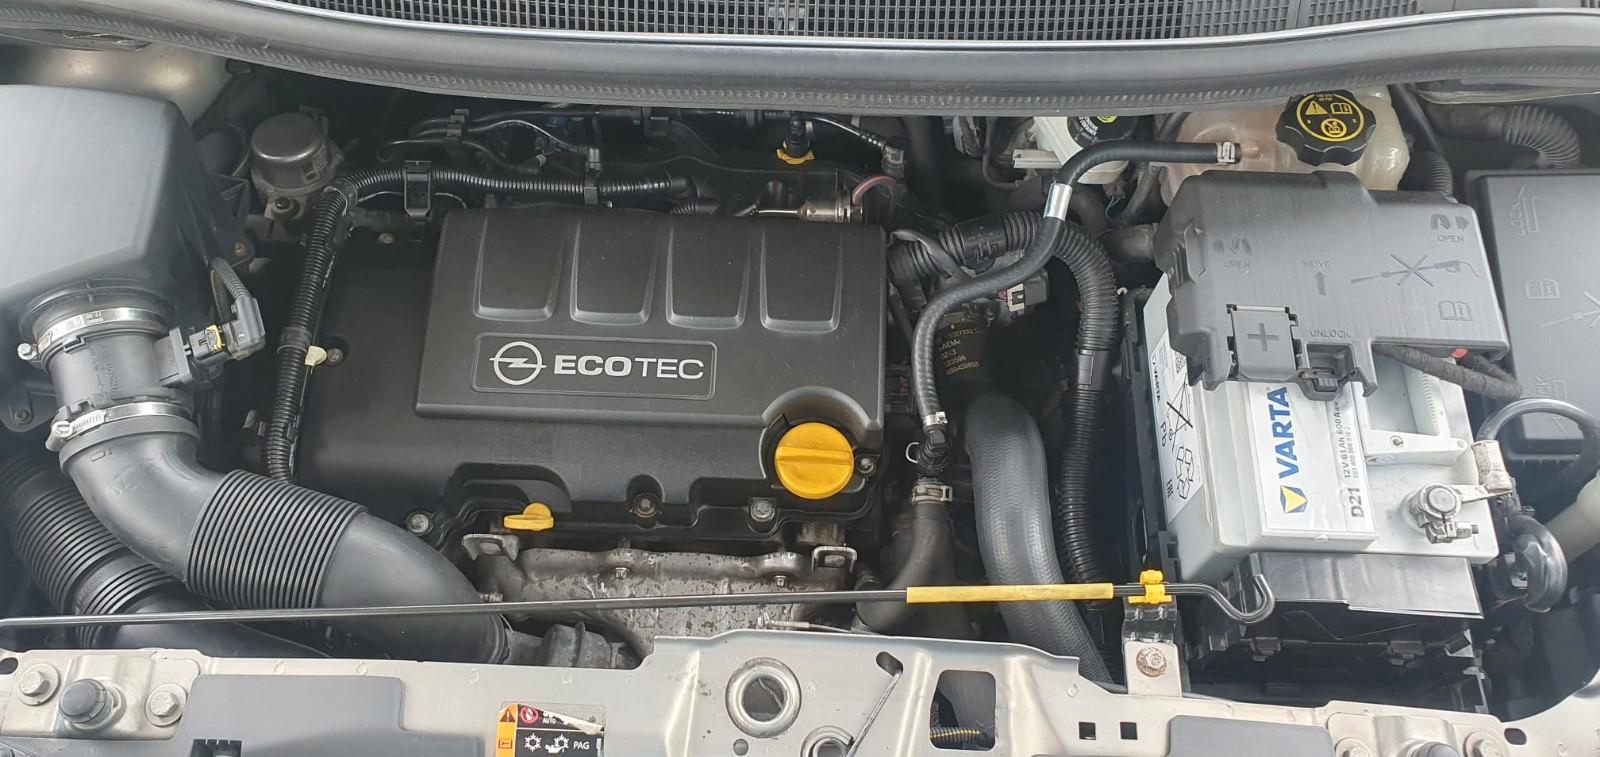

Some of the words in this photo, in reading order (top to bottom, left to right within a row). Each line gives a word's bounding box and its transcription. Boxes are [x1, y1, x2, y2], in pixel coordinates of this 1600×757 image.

[1437, 234, 1465, 244] OPEN
[1223, 260, 1251, 269] OPEN
[1302, 259, 1332, 269] MOVE
[1309, 328, 1351, 338] UNLOCK
[553, 354, 704, 380] ECOTEC
[1160, 421, 1167, 448] Pb
[1266, 386, 1299, 479] VARTA
[1347, 487, 1365, 518] D21
[542, 717, 557, 725] AUTO
[573, 741, 590, 750] PAG
